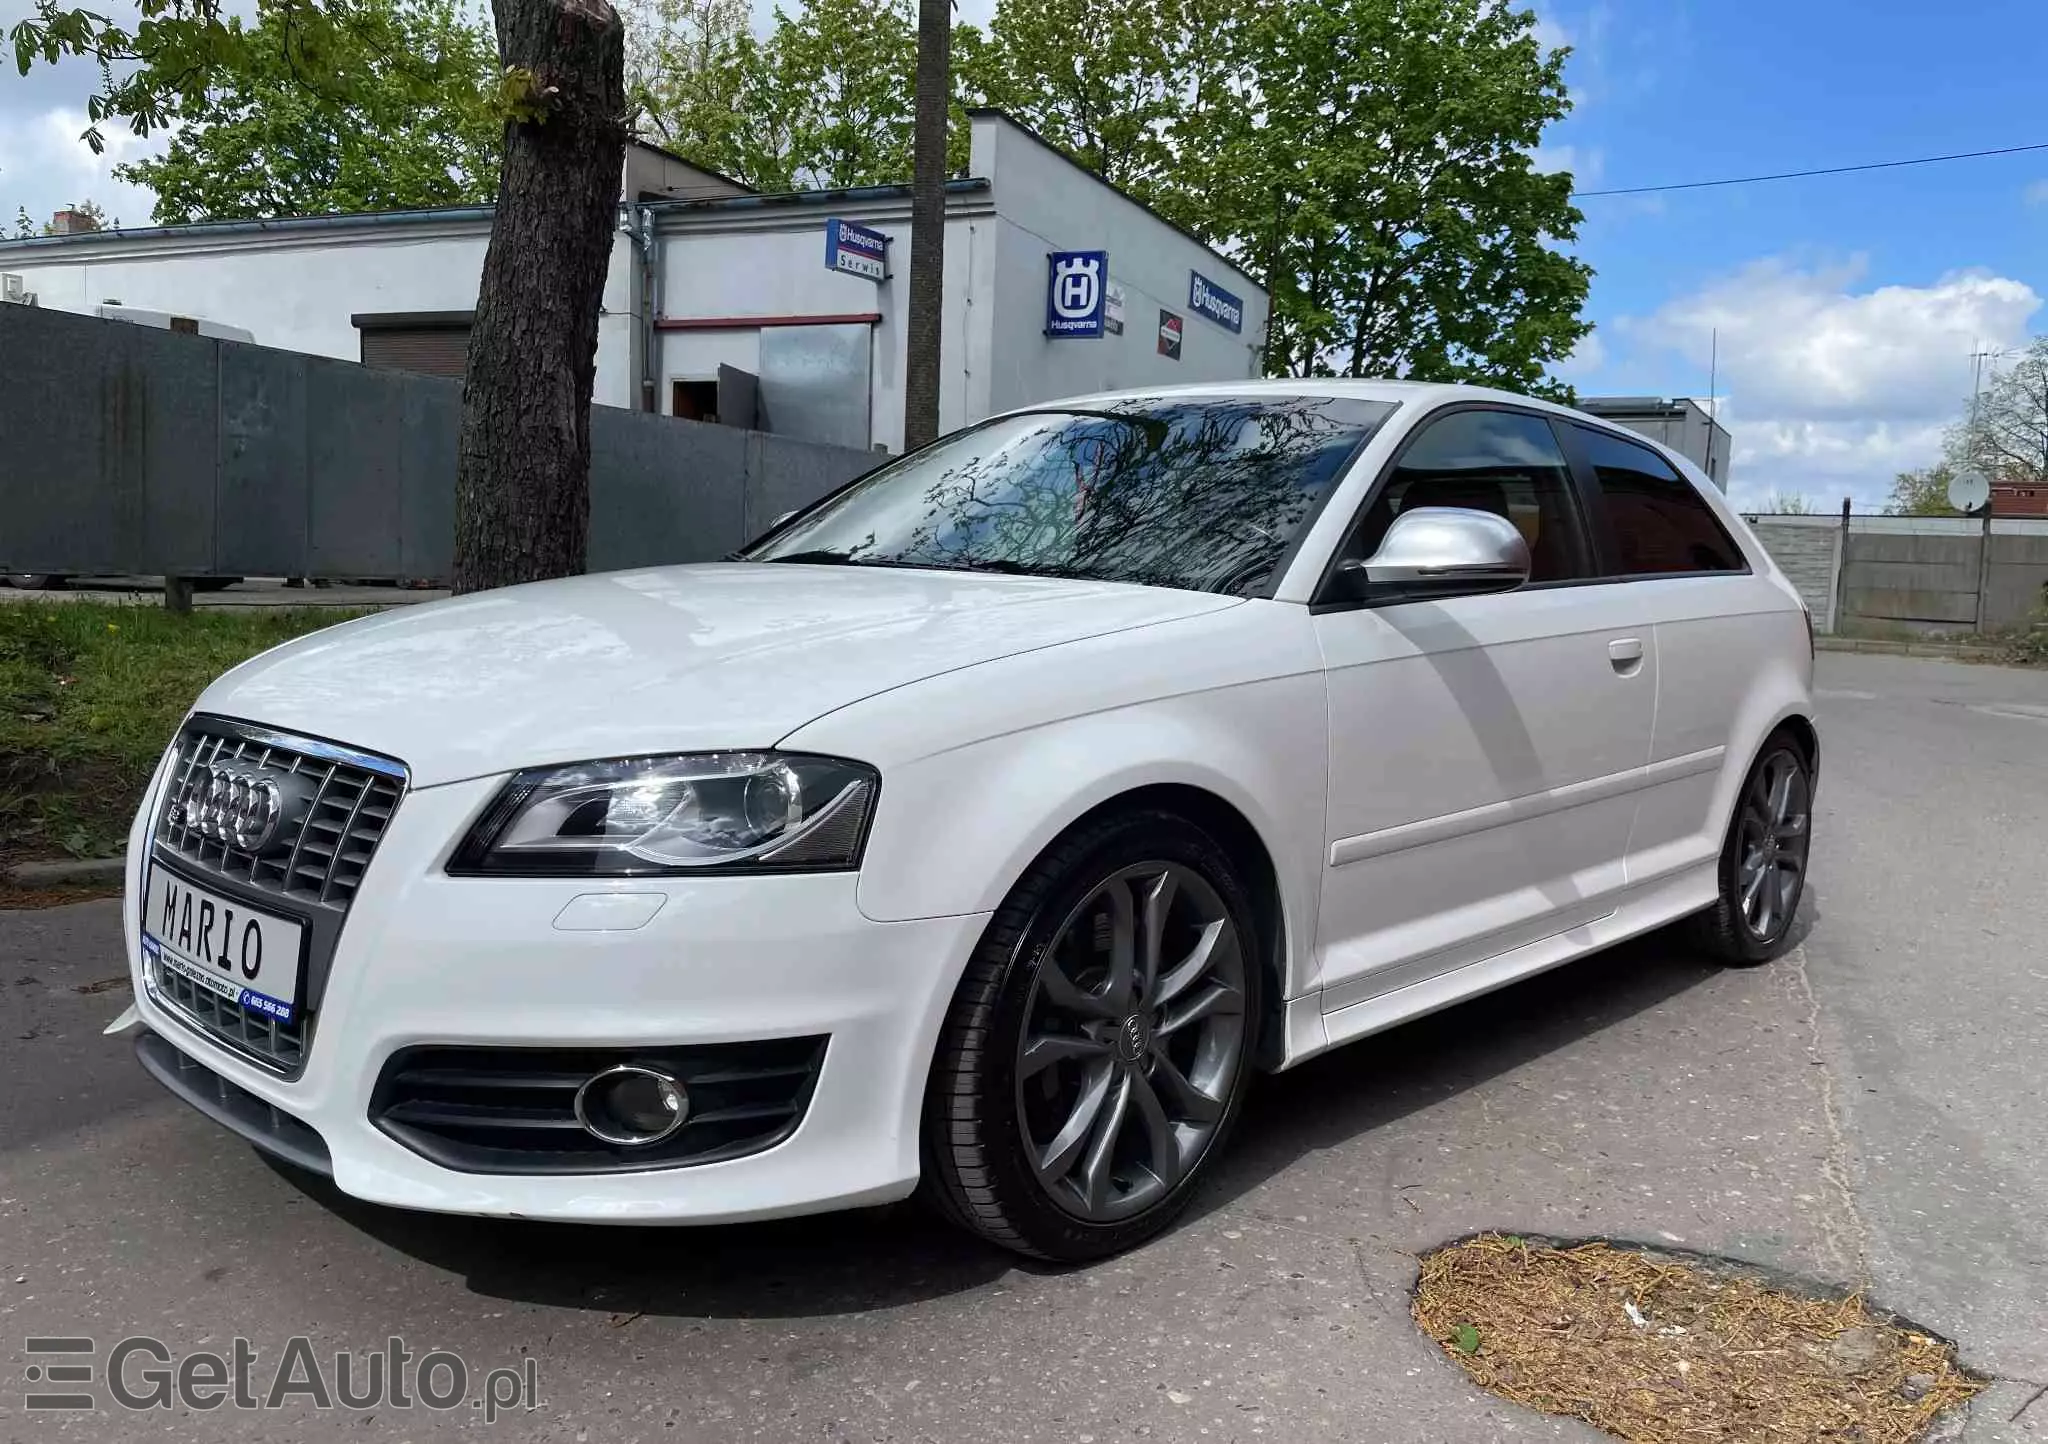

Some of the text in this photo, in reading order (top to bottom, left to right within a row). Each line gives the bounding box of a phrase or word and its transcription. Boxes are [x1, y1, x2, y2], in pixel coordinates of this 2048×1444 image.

[847, 227, 884, 251] Husqvarna
[840, 254, 881, 276] Serwis
[1202, 284, 1240, 325] Husqvarna
[1051, 320, 1098, 330] Husqvarna
[162, 879, 262, 980] MARIO
